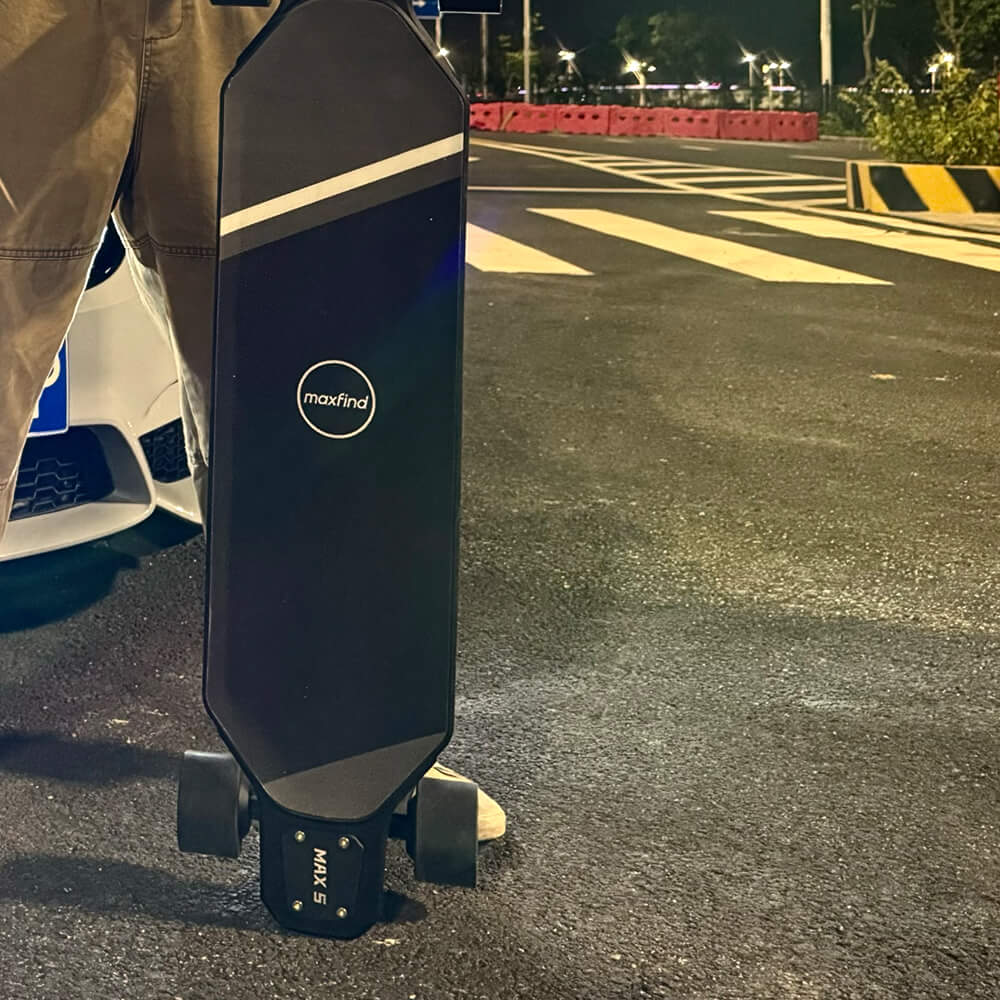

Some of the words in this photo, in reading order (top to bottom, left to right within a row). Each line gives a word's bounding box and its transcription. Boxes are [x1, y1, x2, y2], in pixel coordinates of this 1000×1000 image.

[303, 392, 369, 410] maxfind
[313, 848, 327, 888] MAX
[313, 891, 327, 905] 5
